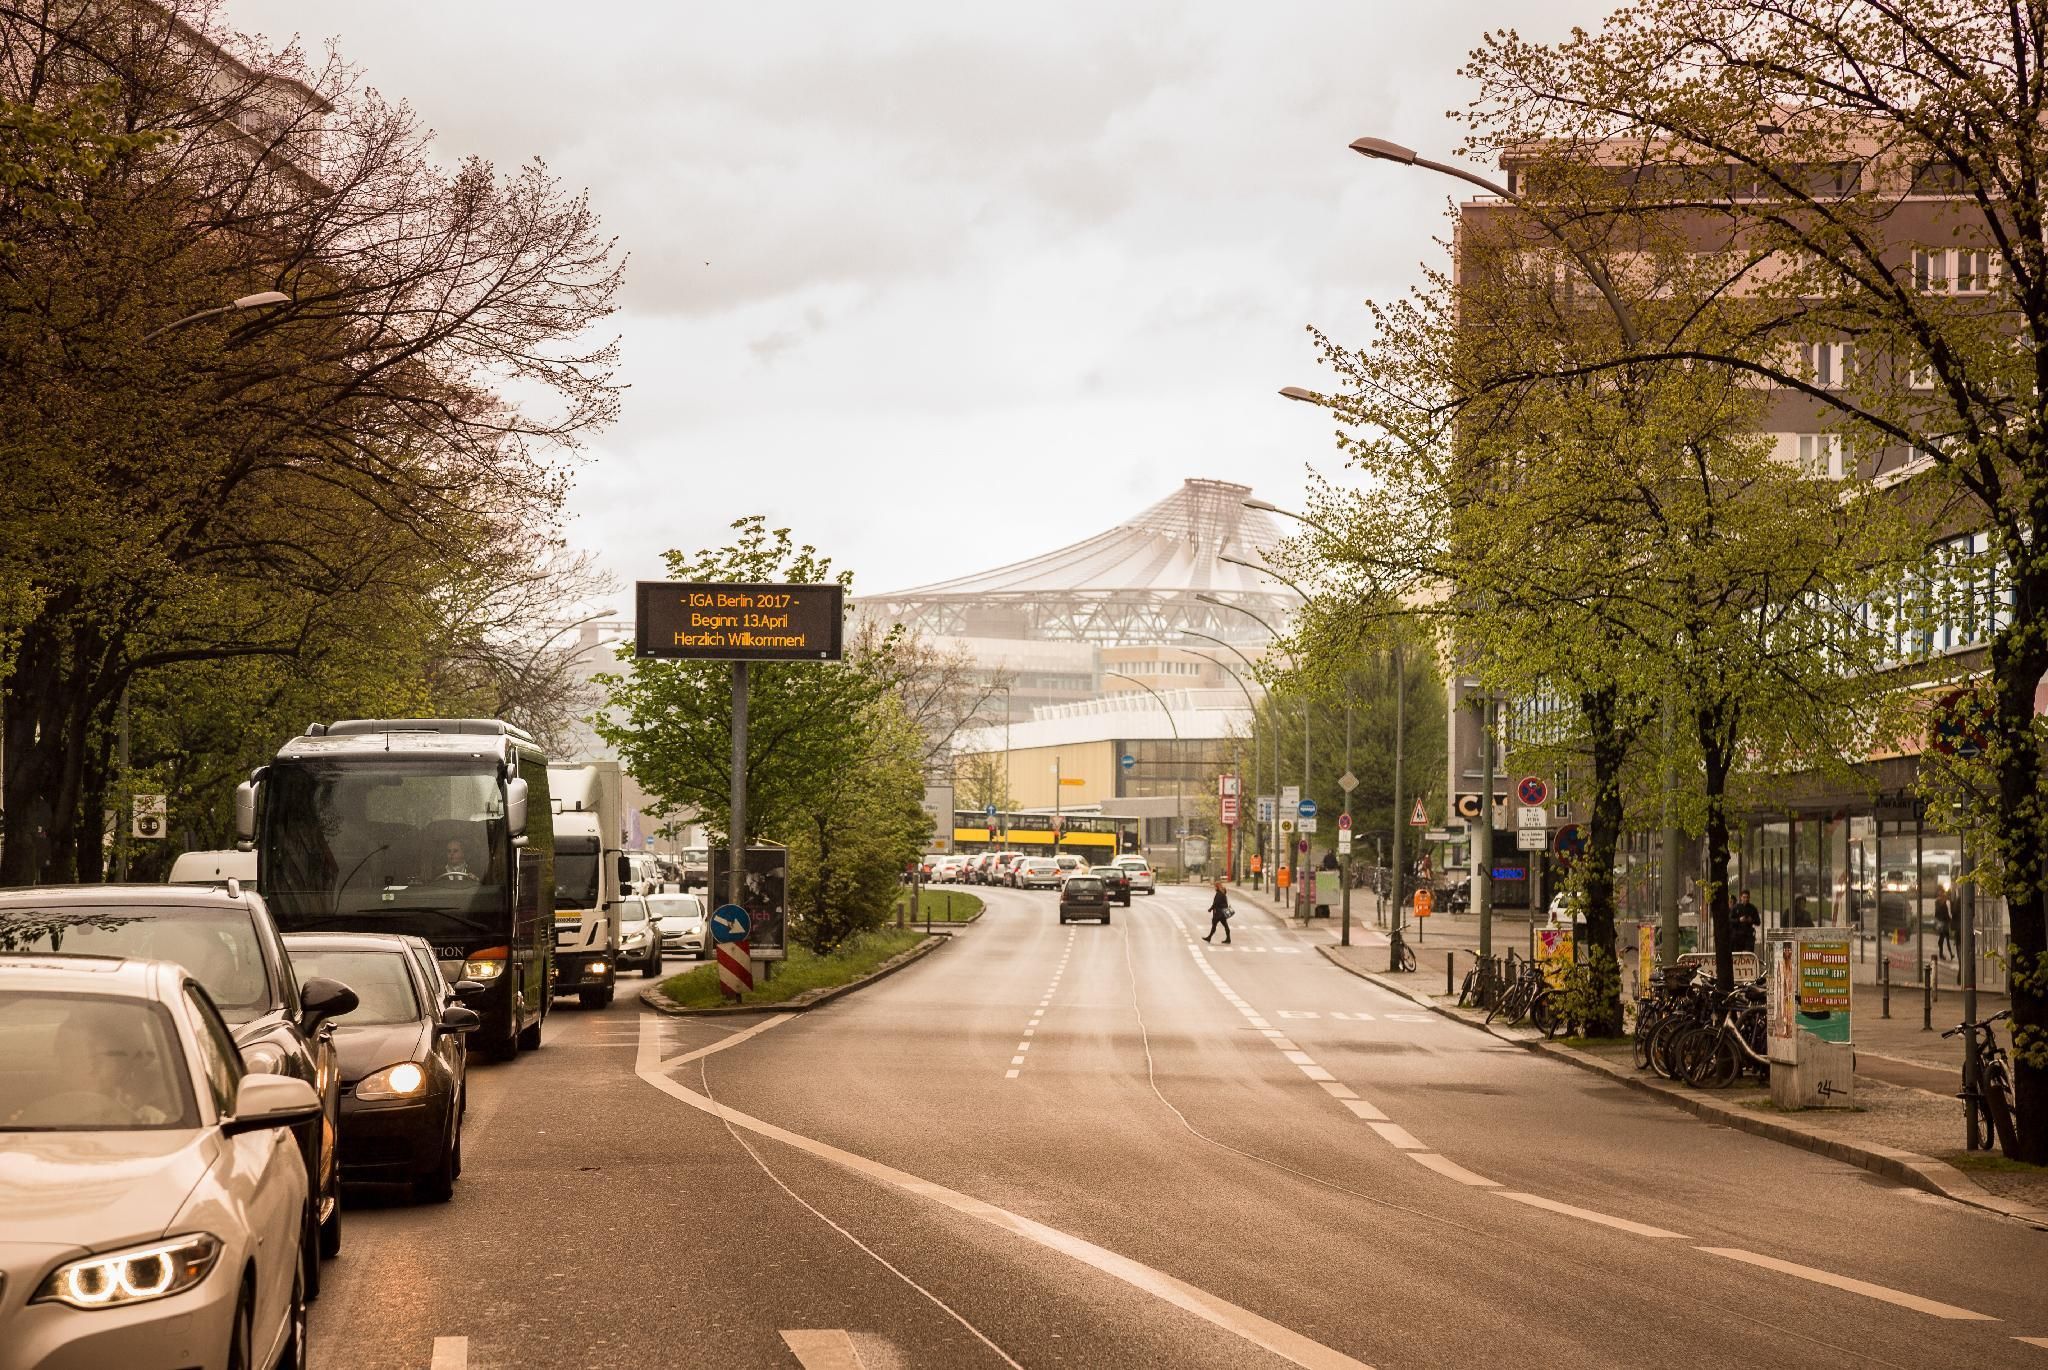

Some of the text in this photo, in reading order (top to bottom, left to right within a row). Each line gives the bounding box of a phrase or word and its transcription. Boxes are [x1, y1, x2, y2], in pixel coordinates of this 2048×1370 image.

[689, 594, 714, 607] IGA
[718, 594, 753, 607] Berlin
[757, 595, 791, 607] 2017
[692, 614, 788, 630] Beginn: 13.April
[674, 632, 805, 647] Herzlich Willkommen!
